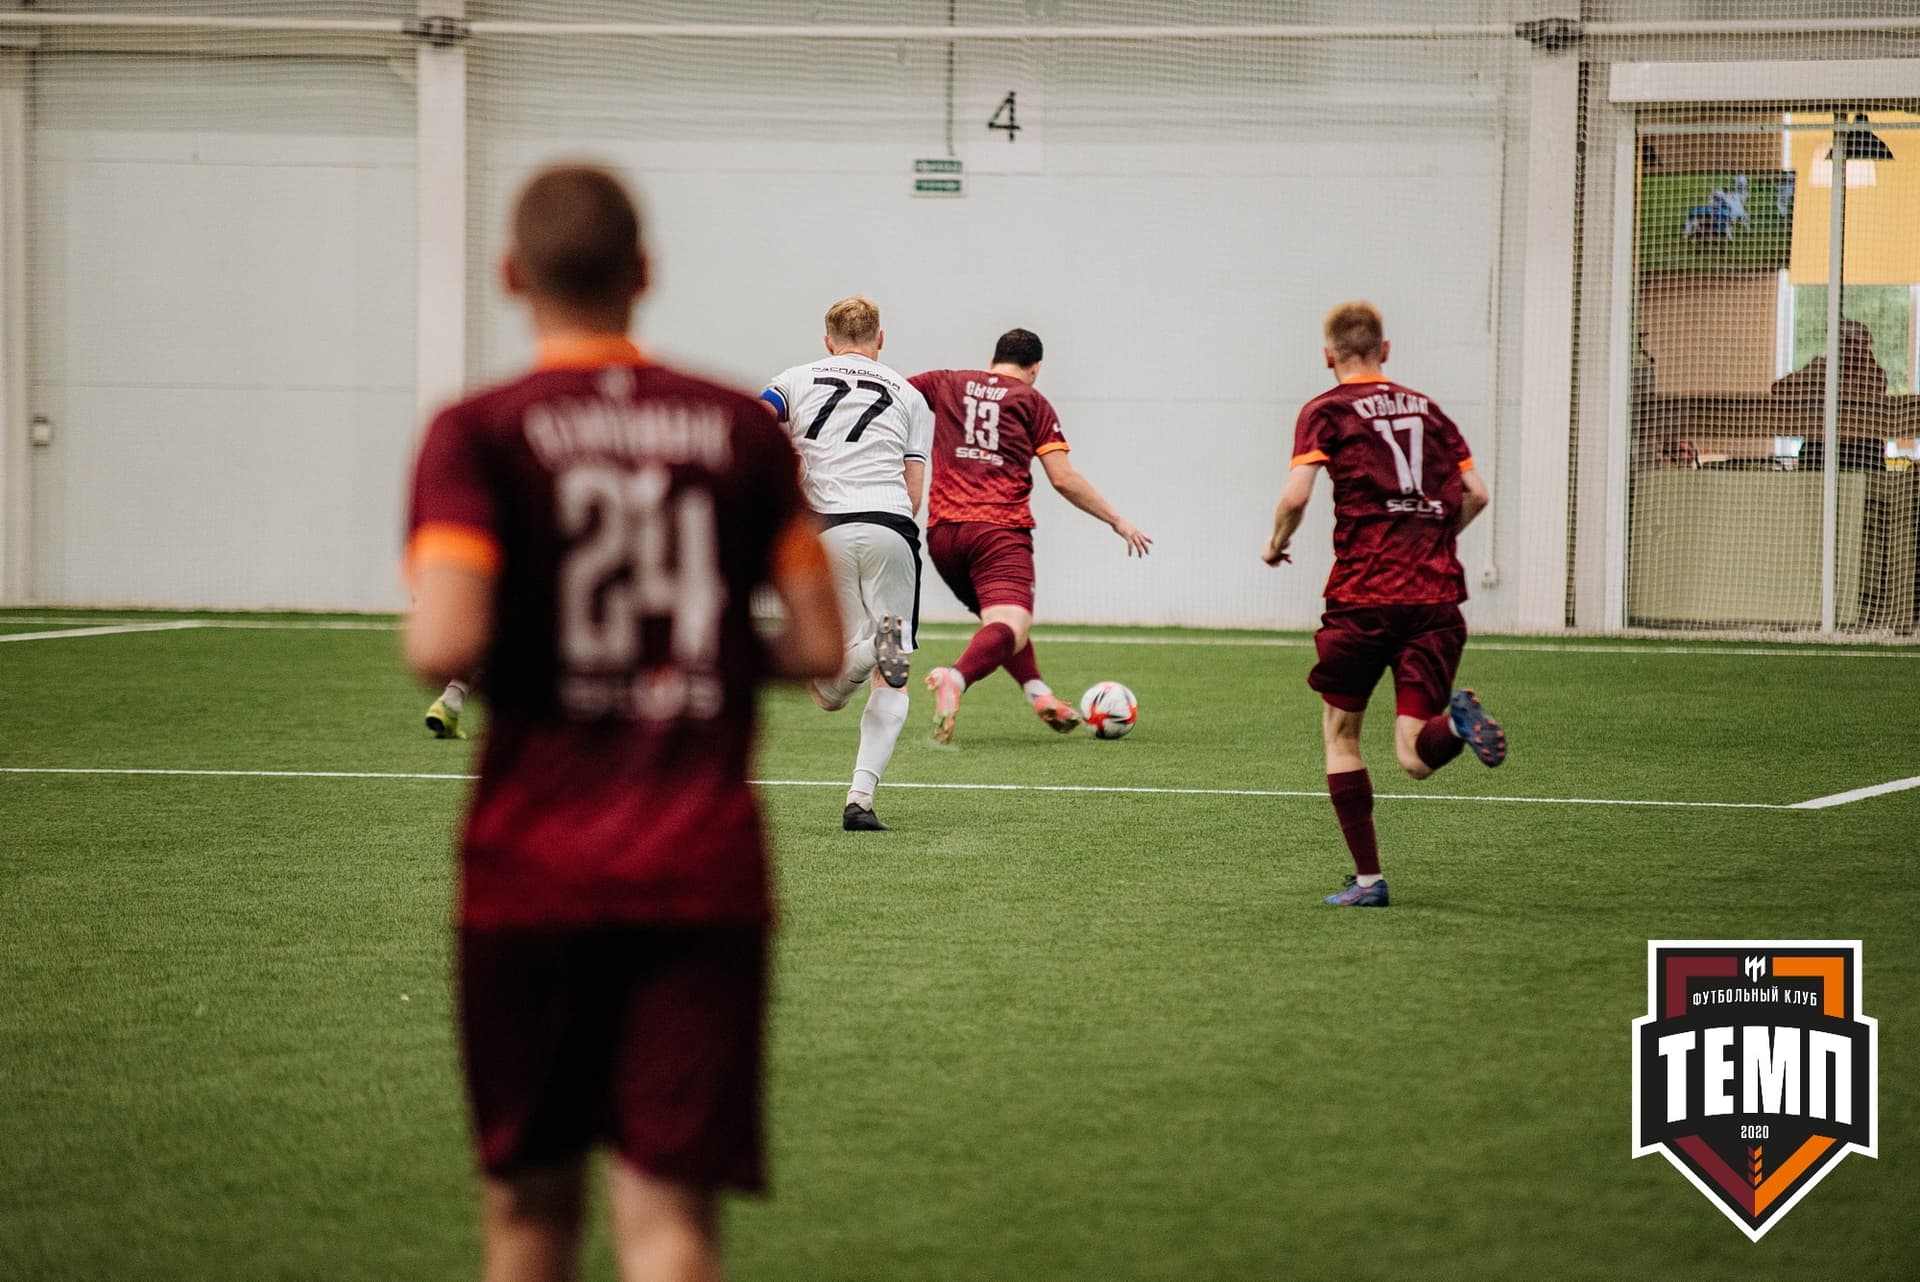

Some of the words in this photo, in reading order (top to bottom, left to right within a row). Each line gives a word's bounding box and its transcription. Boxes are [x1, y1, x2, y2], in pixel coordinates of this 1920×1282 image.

[989, 91, 1022, 141] 4
[804, 376, 894, 442] 77
[962, 395, 1001, 451] 13
[1372, 416, 1424, 497] 17
[554, 460, 724, 666] 24
